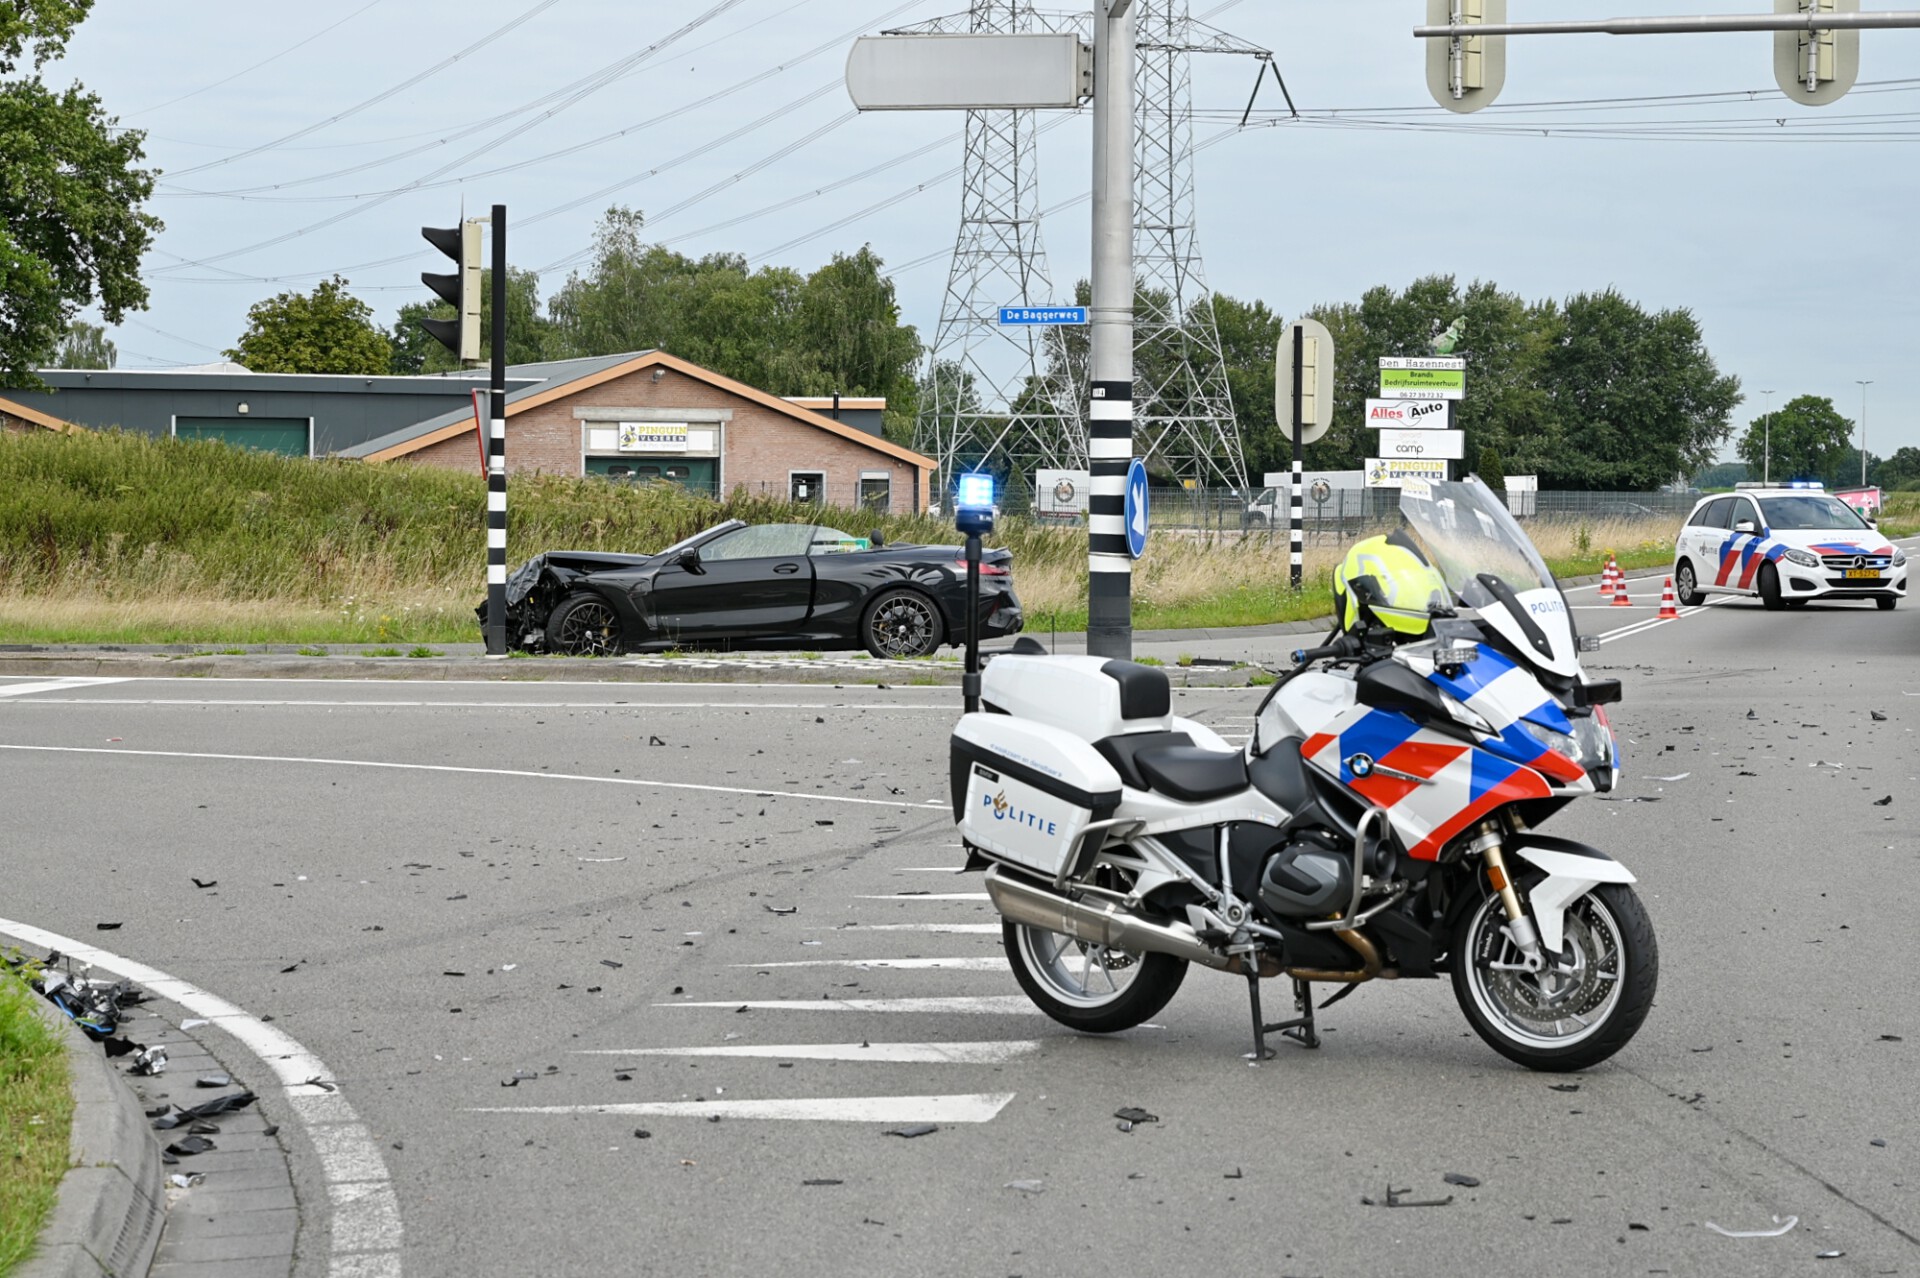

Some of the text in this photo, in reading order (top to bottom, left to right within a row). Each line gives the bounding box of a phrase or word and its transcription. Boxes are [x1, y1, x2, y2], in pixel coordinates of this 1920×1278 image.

[1007, 310, 1078, 321] De Baggerweg
[1380, 359, 1463, 368] Den Hazennest
[1384, 379, 1459, 387] Bedrijfsruimteverhuur
[1371, 403, 1443, 419] Alles Auto
[639, 426, 686, 434] PINGUIN
[1396, 445, 1424, 455] camp
[1390, 461, 1444, 470] PINGUIN
[1531, 601, 1565, 614] POLITIE
[984, 793, 1056, 836] POLITIE
